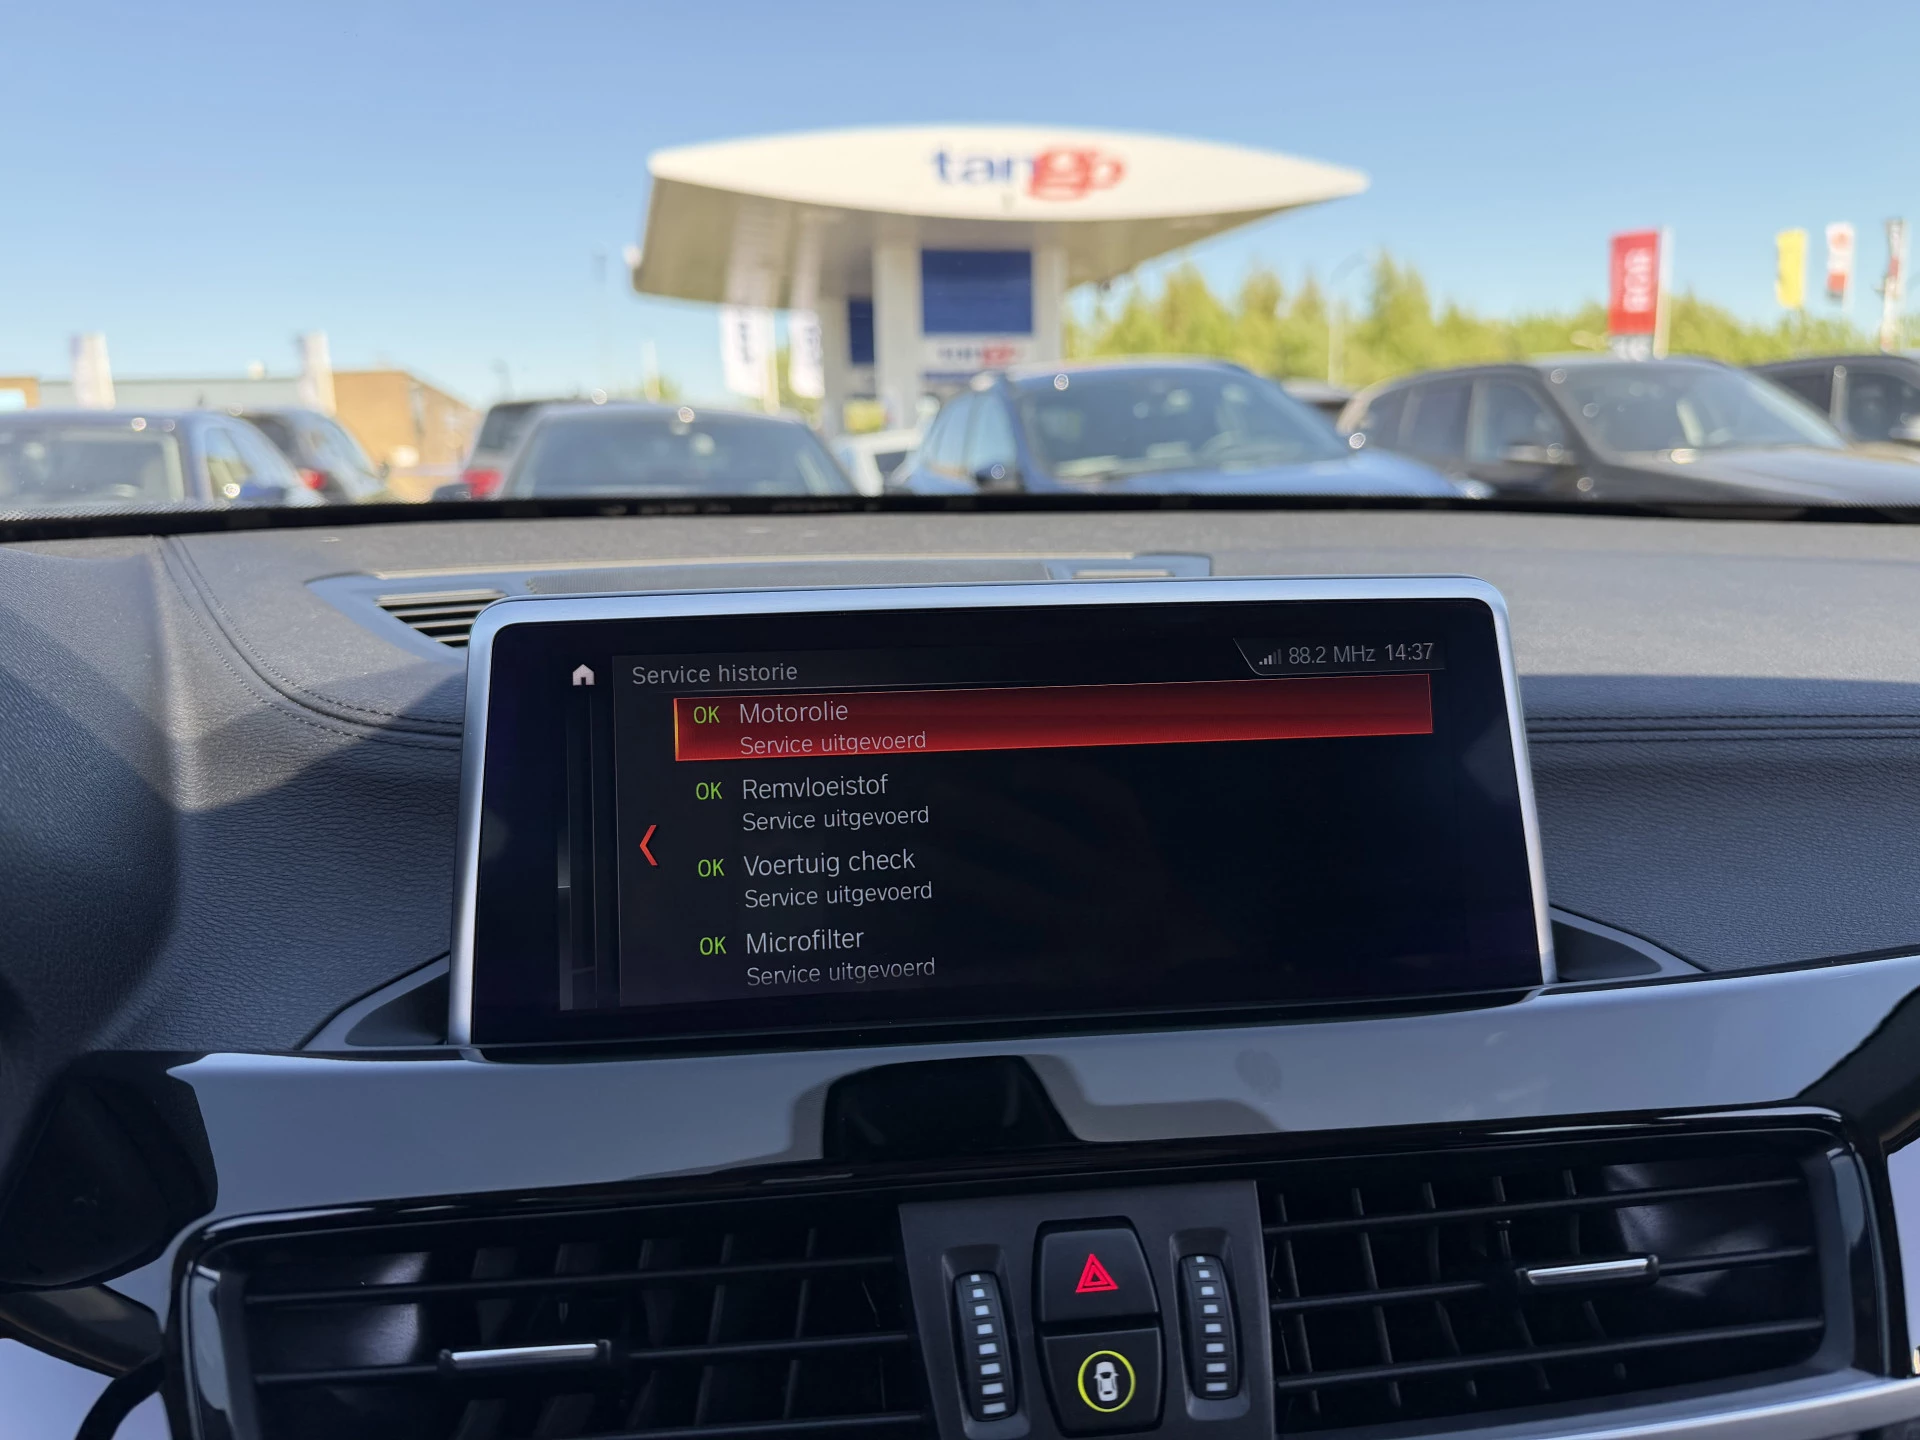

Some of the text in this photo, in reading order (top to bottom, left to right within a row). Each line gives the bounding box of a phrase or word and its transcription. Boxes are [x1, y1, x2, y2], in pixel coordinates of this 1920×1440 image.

[931, 148, 1125, 201] tango
[1289, 645, 1376, 665] 88.2 MHz
[1384, 642, 1434, 661] 14:37
[632, 664, 798, 685] Service historie
[693, 701, 849, 724] OK Motorolie
[740, 731, 927, 755] Service uitgevoerd
[695, 774, 889, 800] OK Remvloeistof
[743, 806, 930, 831] Service uitgevoerd
[698, 848, 916, 877] OK Voertuig check
[744, 882, 932, 908] Service uitgevoerd
[699, 929, 864, 955] OK Microfilter
[747, 957, 936, 986] Service uitgevoerd
